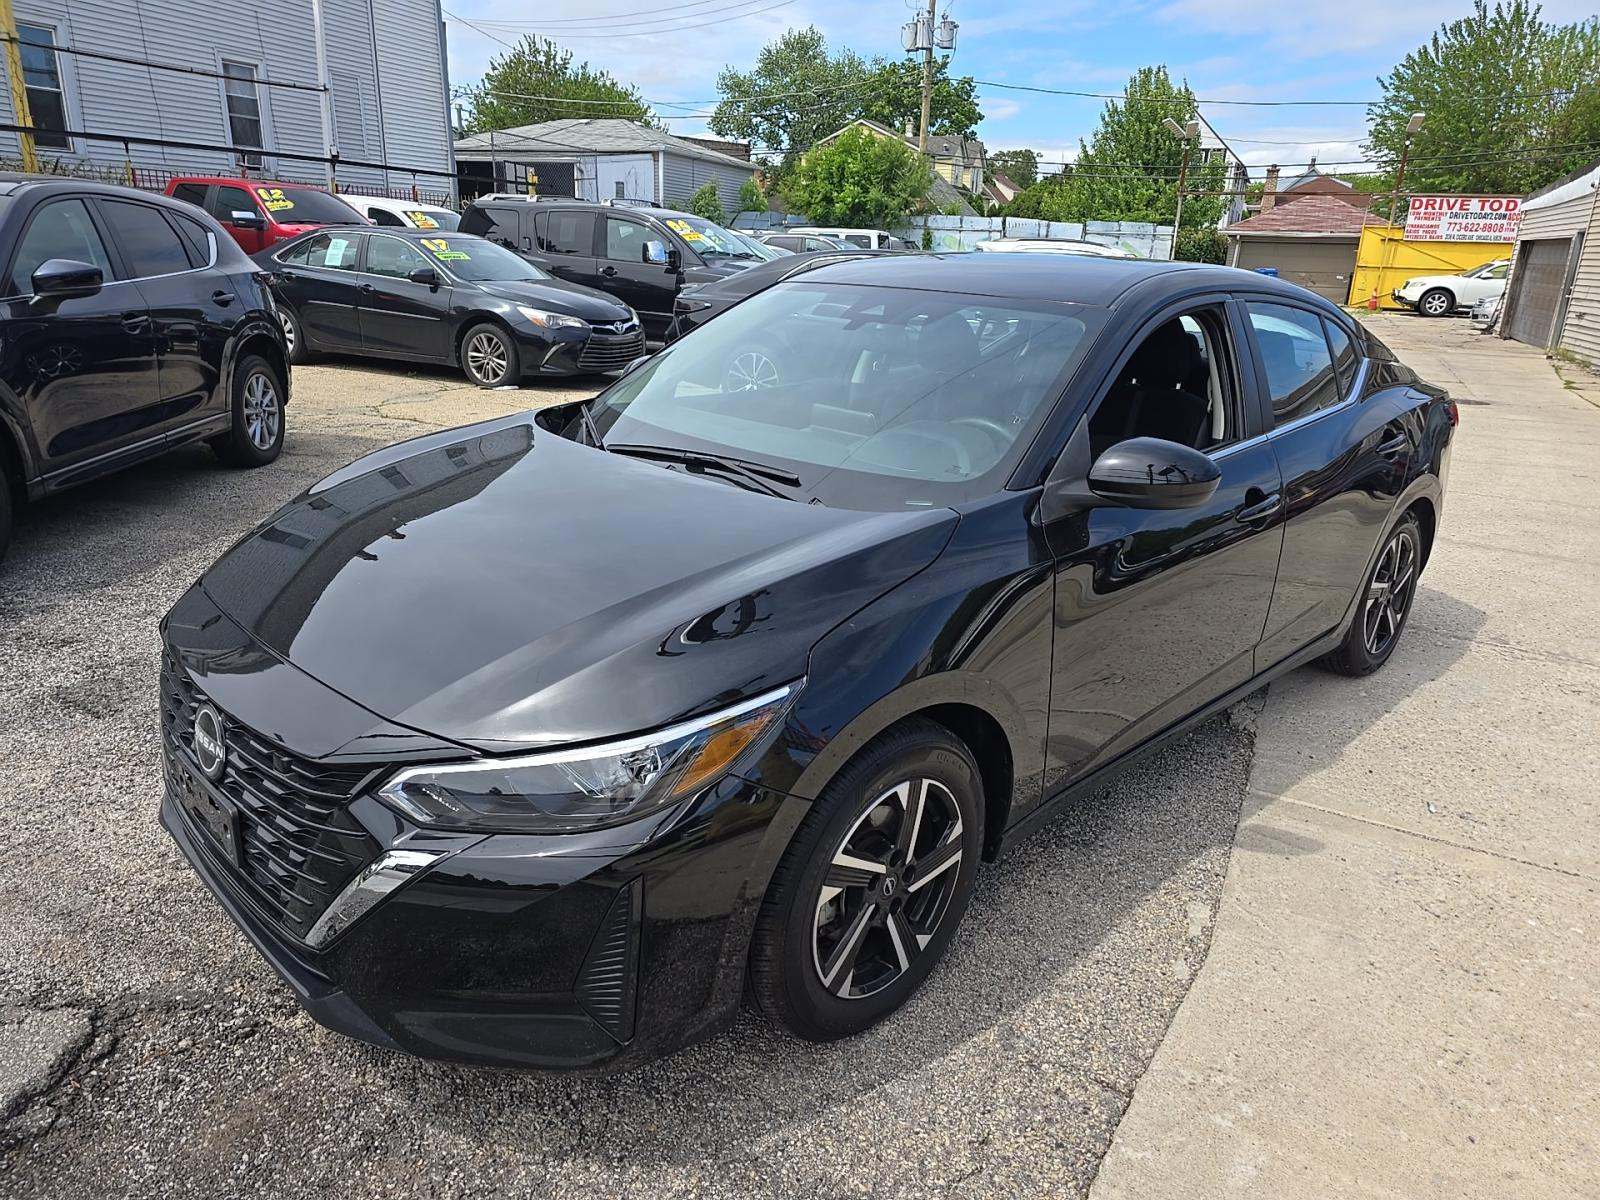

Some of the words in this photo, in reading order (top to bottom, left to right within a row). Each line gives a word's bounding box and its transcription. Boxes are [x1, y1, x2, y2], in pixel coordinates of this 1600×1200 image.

[1410, 198, 1472, 211] DRIVE
[1449, 211, 1508, 221] DRIVETODAY2.COM
[1446, 222, 1505, 233] 773-622-8808
[420, 239, 450, 251] 17
